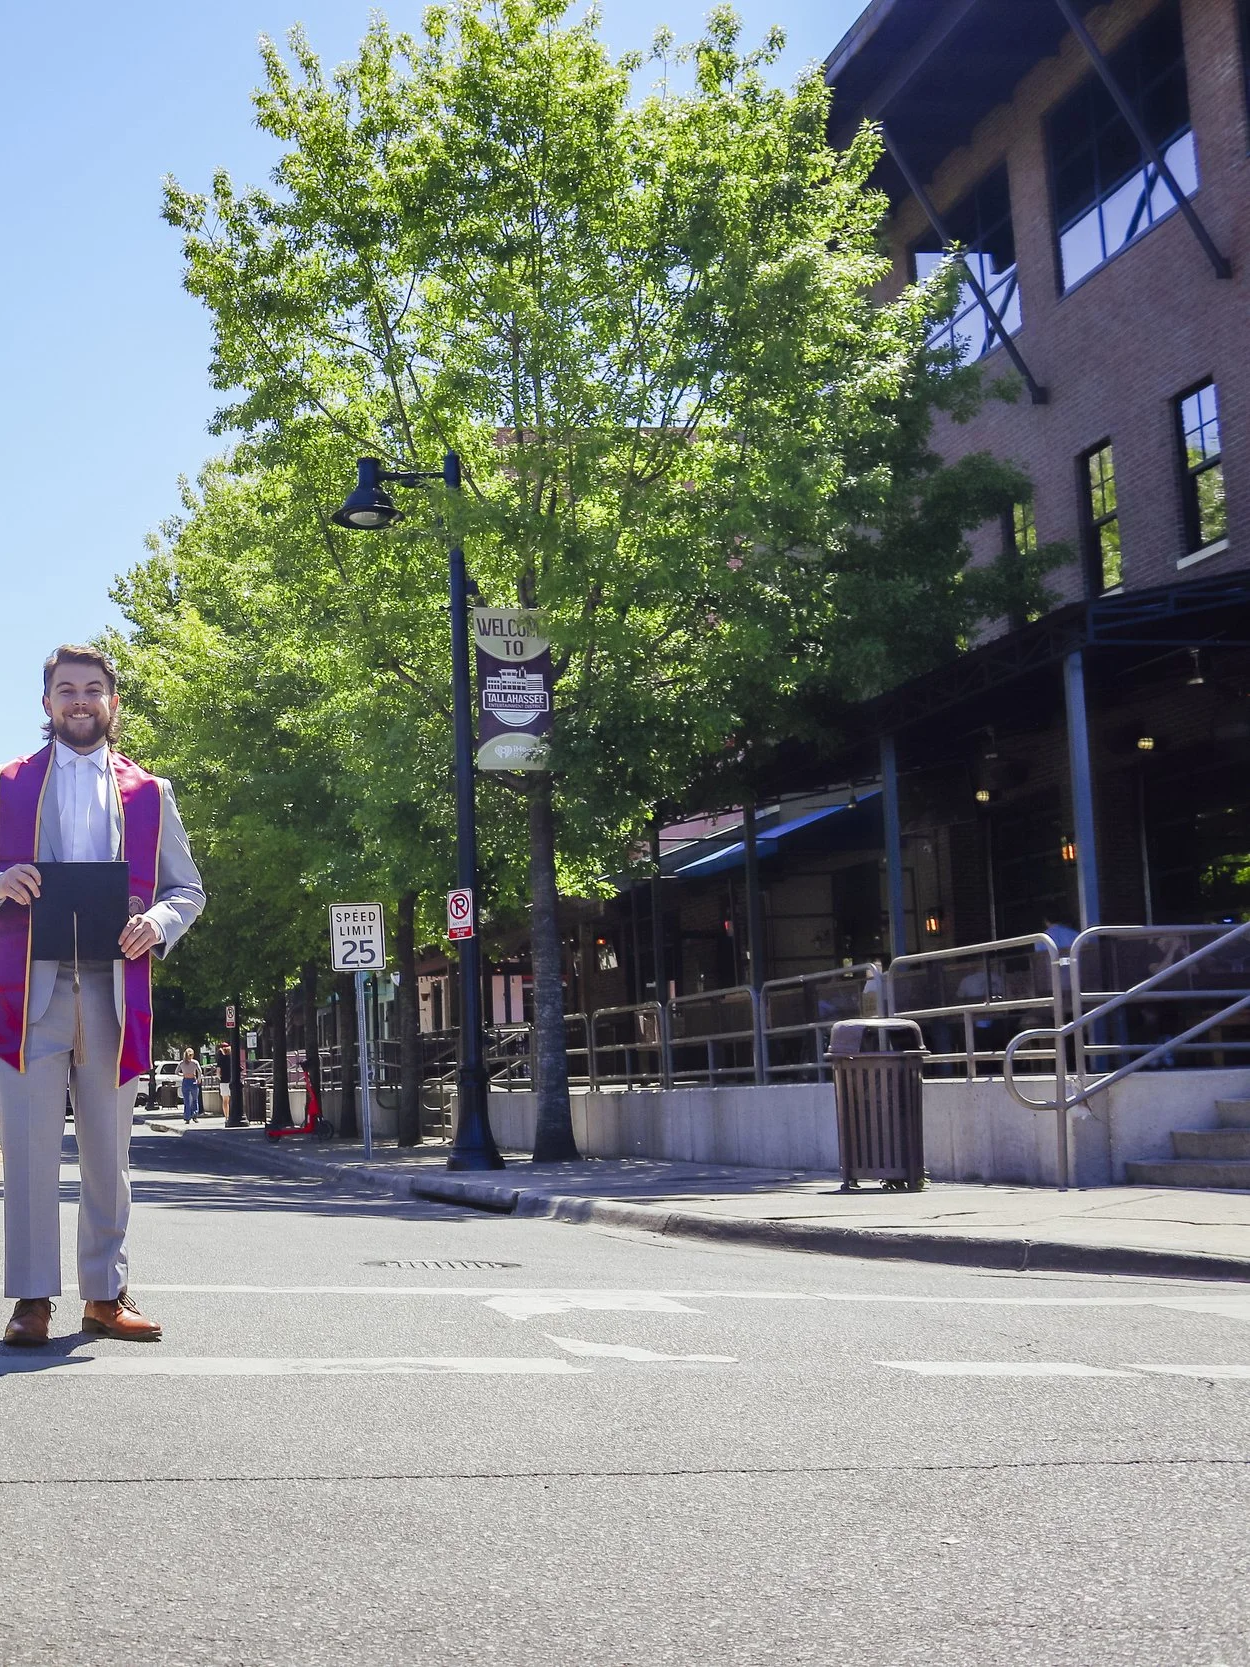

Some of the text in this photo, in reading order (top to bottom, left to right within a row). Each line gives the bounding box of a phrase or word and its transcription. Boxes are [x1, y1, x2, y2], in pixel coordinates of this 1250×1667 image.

[503, 640, 524, 656] TO
[487, 693, 544, 704] TALLAHASSEE
[336, 911, 376, 923] SPEED
[339, 925, 374, 937] LIMIT
[341, 939, 376, 965] 25
